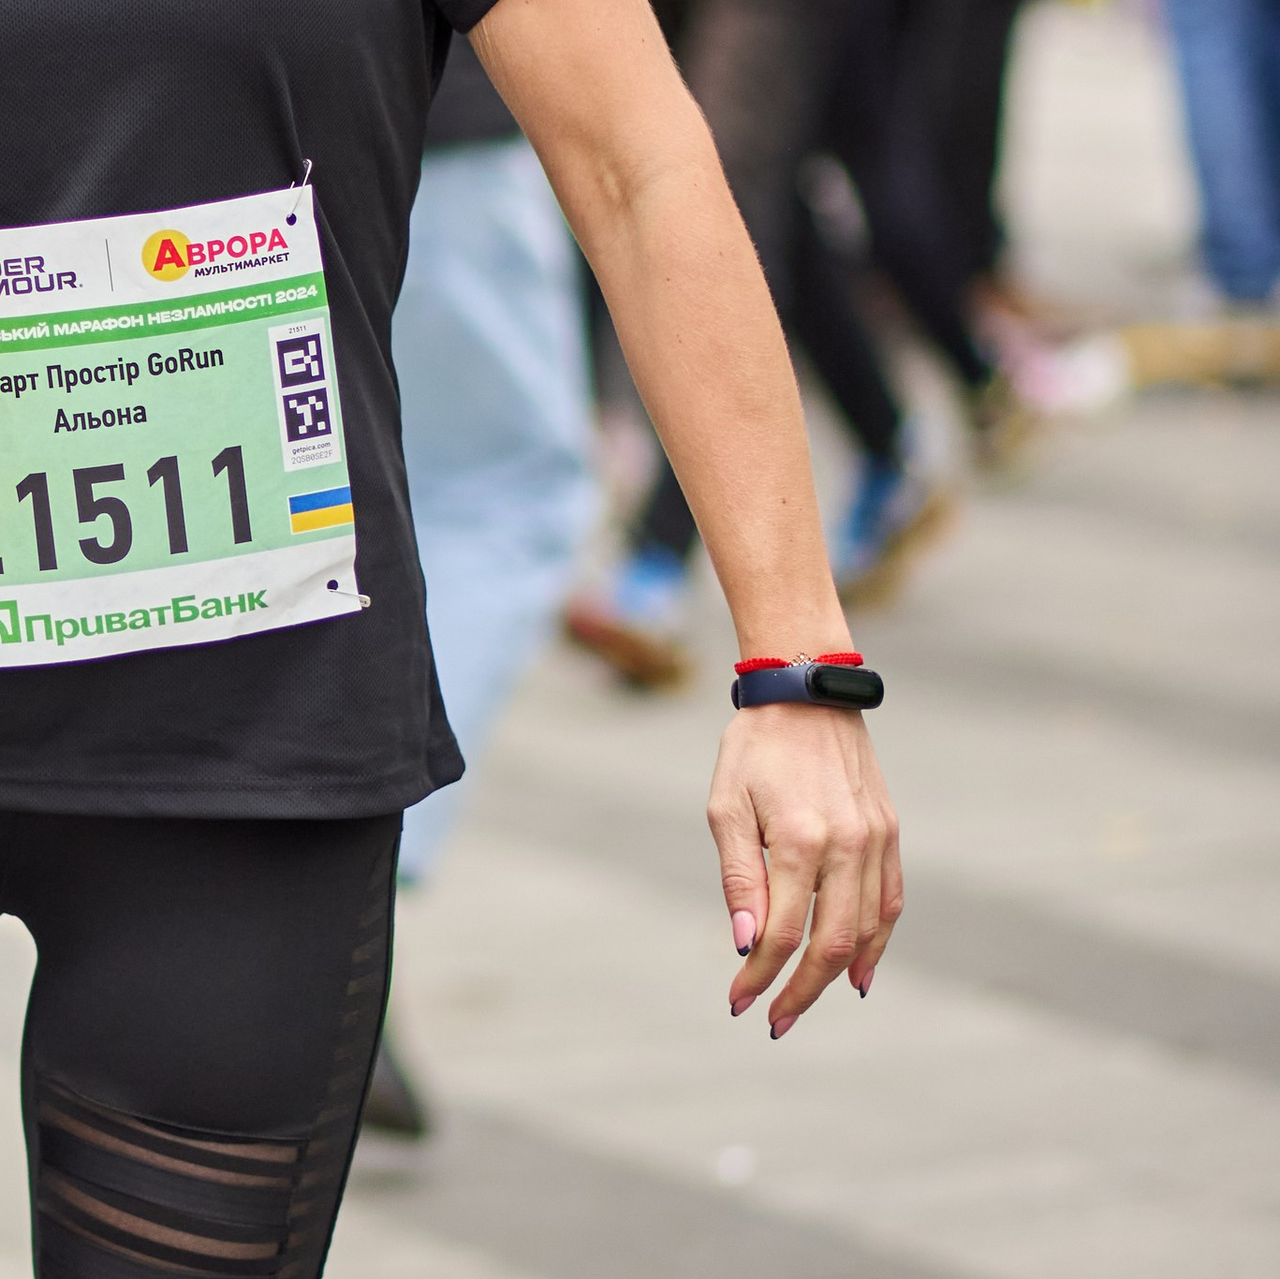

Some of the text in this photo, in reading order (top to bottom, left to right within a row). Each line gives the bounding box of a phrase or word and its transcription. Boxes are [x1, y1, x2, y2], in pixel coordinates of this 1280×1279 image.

[153, 228, 288, 271] АВРОРА
[195, 253, 290, 278] МУЛЬТИМАРКЕТ
[54, 314, 144, 336] МАРАФОН
[148, 292, 272, 325] НЕЗЛАМНОСТІ
[275, 285, 317, 304] 2024
[289, 326, 306, 334] 21511
[47, 357, 140, 393] Простір
[148, 346, 224, 376] GoRun
[54, 404, 147, 434] Альона
[292, 441, 330, 455] getpica.com
[24, 589, 268, 645] ПриватБанк
